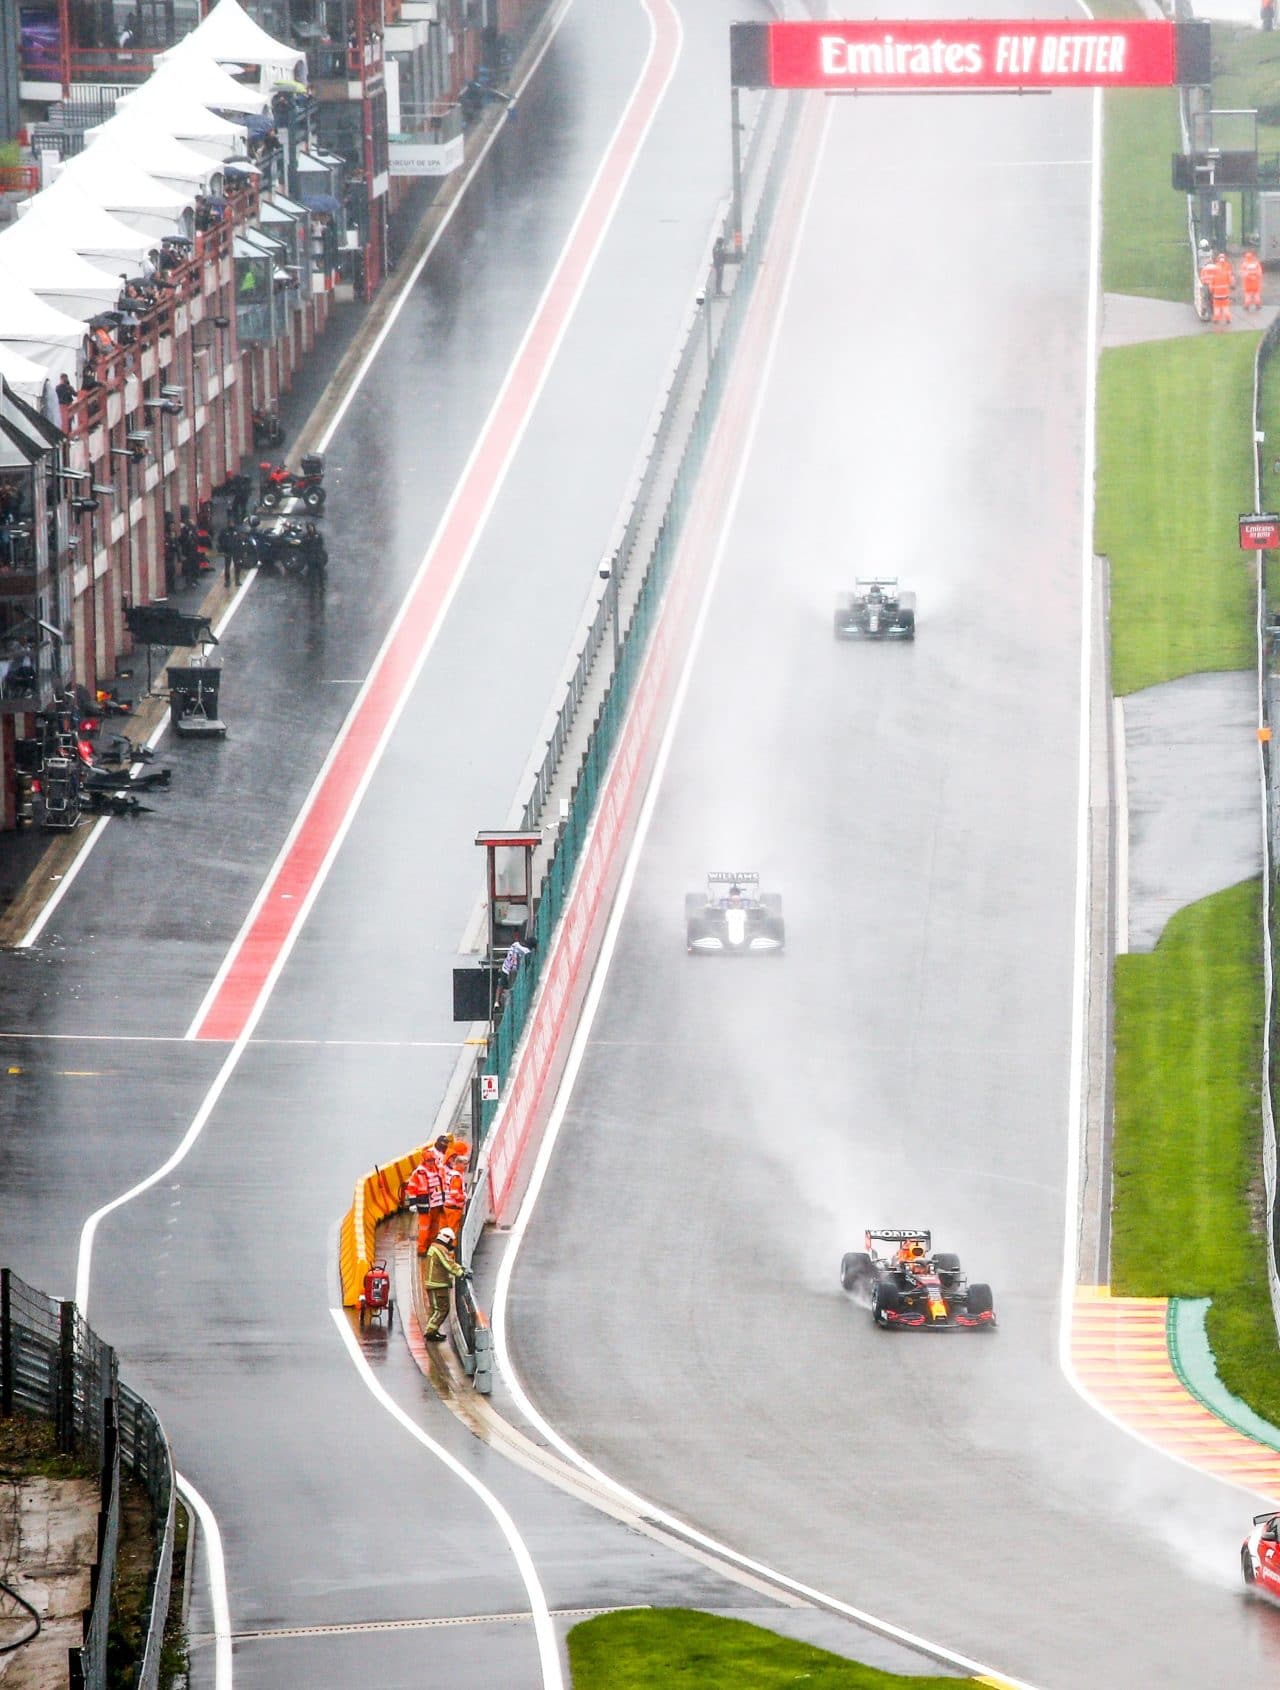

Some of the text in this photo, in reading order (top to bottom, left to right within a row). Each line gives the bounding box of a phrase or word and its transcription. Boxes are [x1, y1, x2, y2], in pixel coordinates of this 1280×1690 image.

[820, 35, 1125, 74] Emirates FLY BETTER
[707, 872, 760, 880] WILLIAMS
